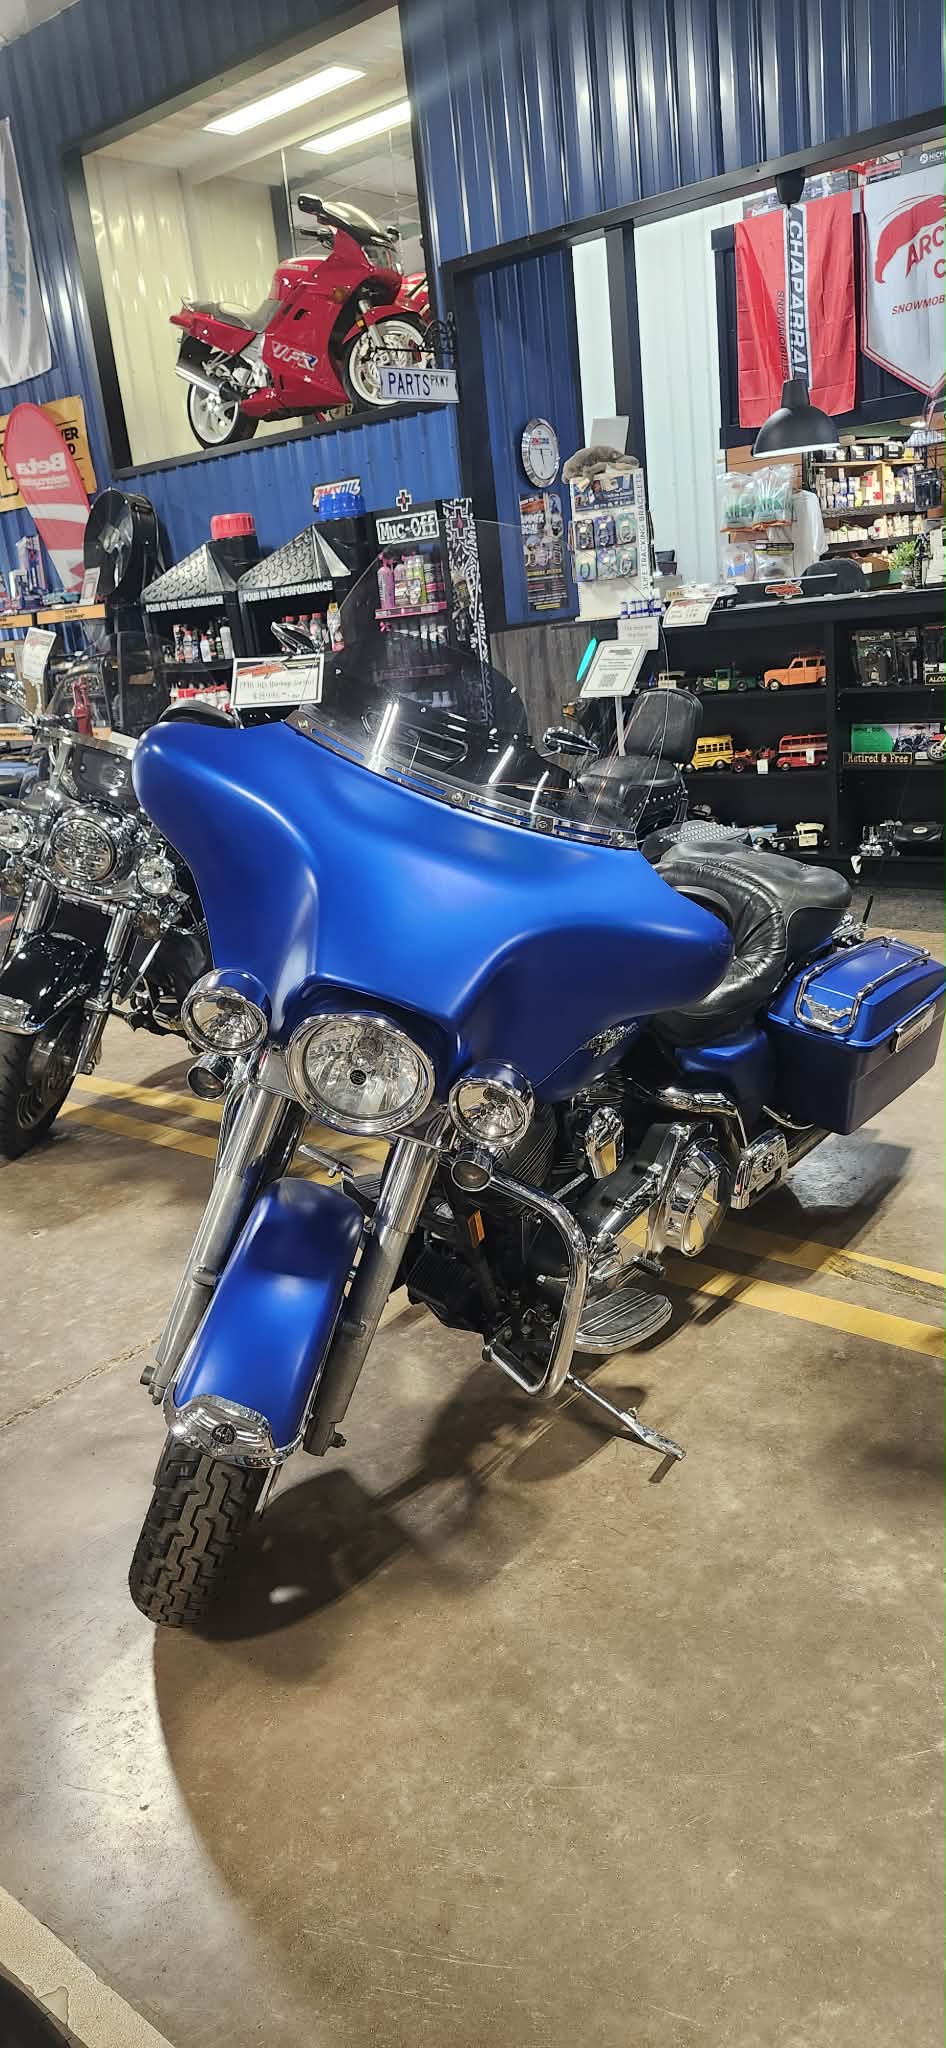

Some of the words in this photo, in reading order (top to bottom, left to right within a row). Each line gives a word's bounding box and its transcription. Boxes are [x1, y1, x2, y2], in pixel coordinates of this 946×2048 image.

[905, 223, 946, 278] ARC
[934, 258, 946, 279] C
[271, 340, 319, 371] VFR
[388, 372, 431, 396] PARTS
[430, 375, 449, 387] PKWY
[640, 527, 649, 567] TRACKING
[280, 580, 333, 597] PERFORMANCE
[178, 595, 224, 609] PERFORMANCE
[928, 675, 946, 683] ALCO
[848, 752, 879, 763] Retired
[890, 752, 909, 763] Free
